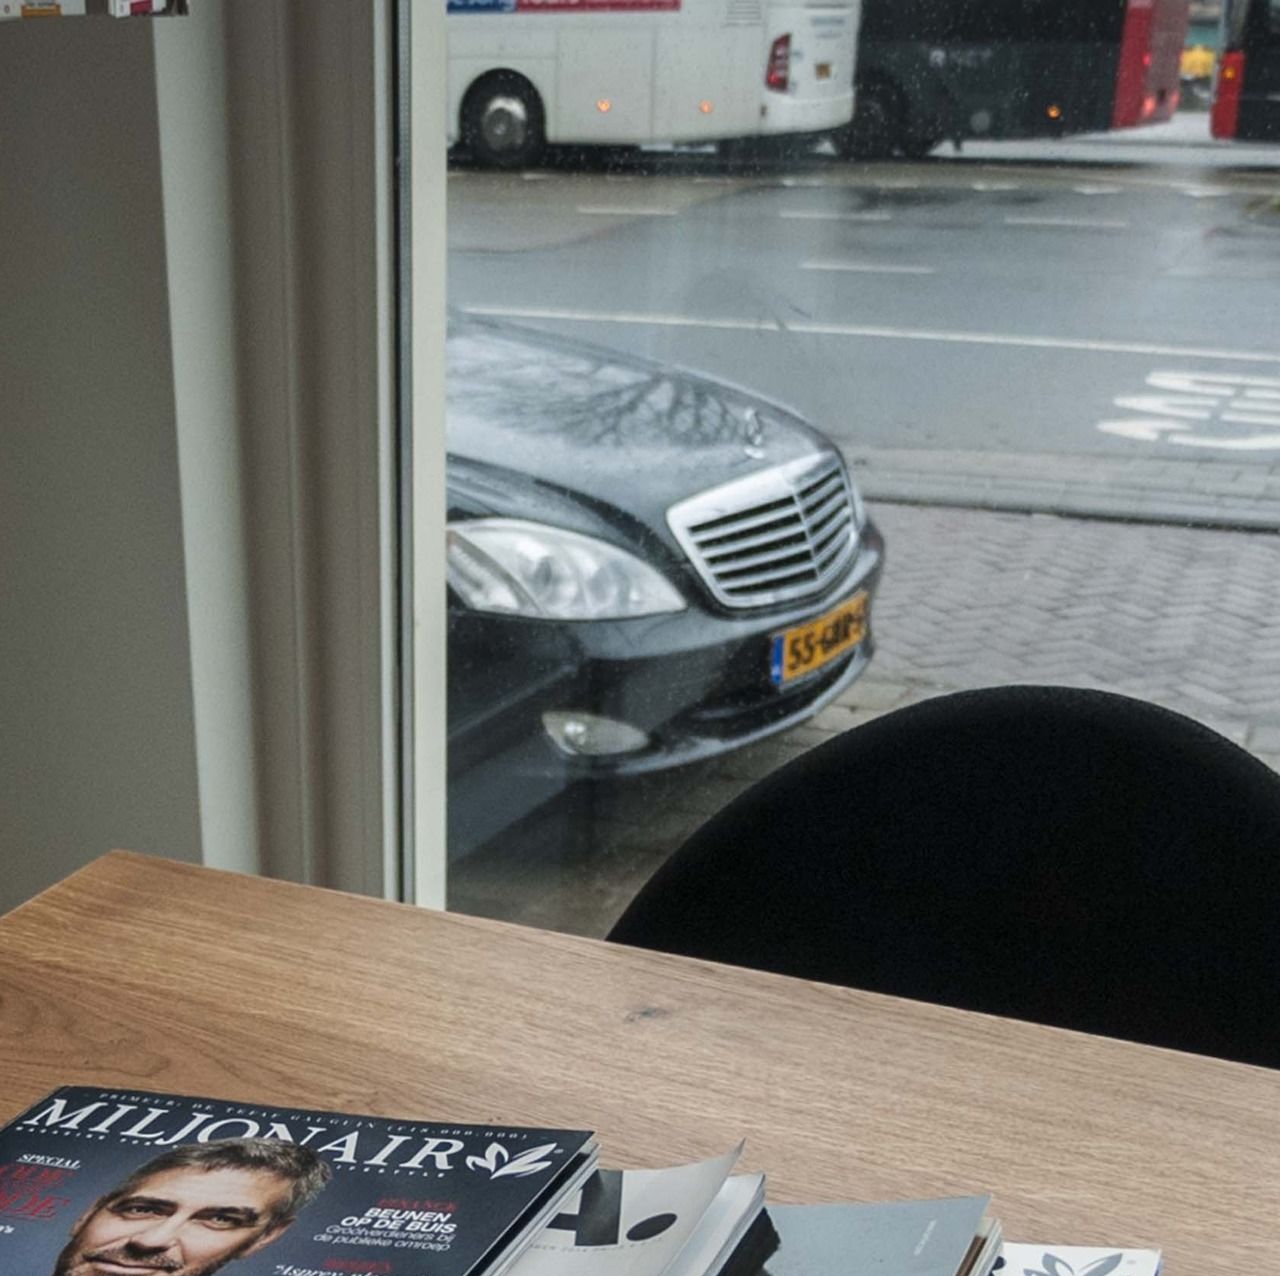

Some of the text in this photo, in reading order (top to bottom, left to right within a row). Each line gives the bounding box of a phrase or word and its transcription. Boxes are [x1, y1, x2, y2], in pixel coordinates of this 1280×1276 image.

[22, 1098, 465, 1171] MILJONAIR
[16, 1153, 81, 1170] SPECIAL
[364, 1207, 451, 1222] BEUNEN
[341, 1216, 458, 1234] OP DE BUIS
[313, 1233, 451, 1251] de publieke omroep
